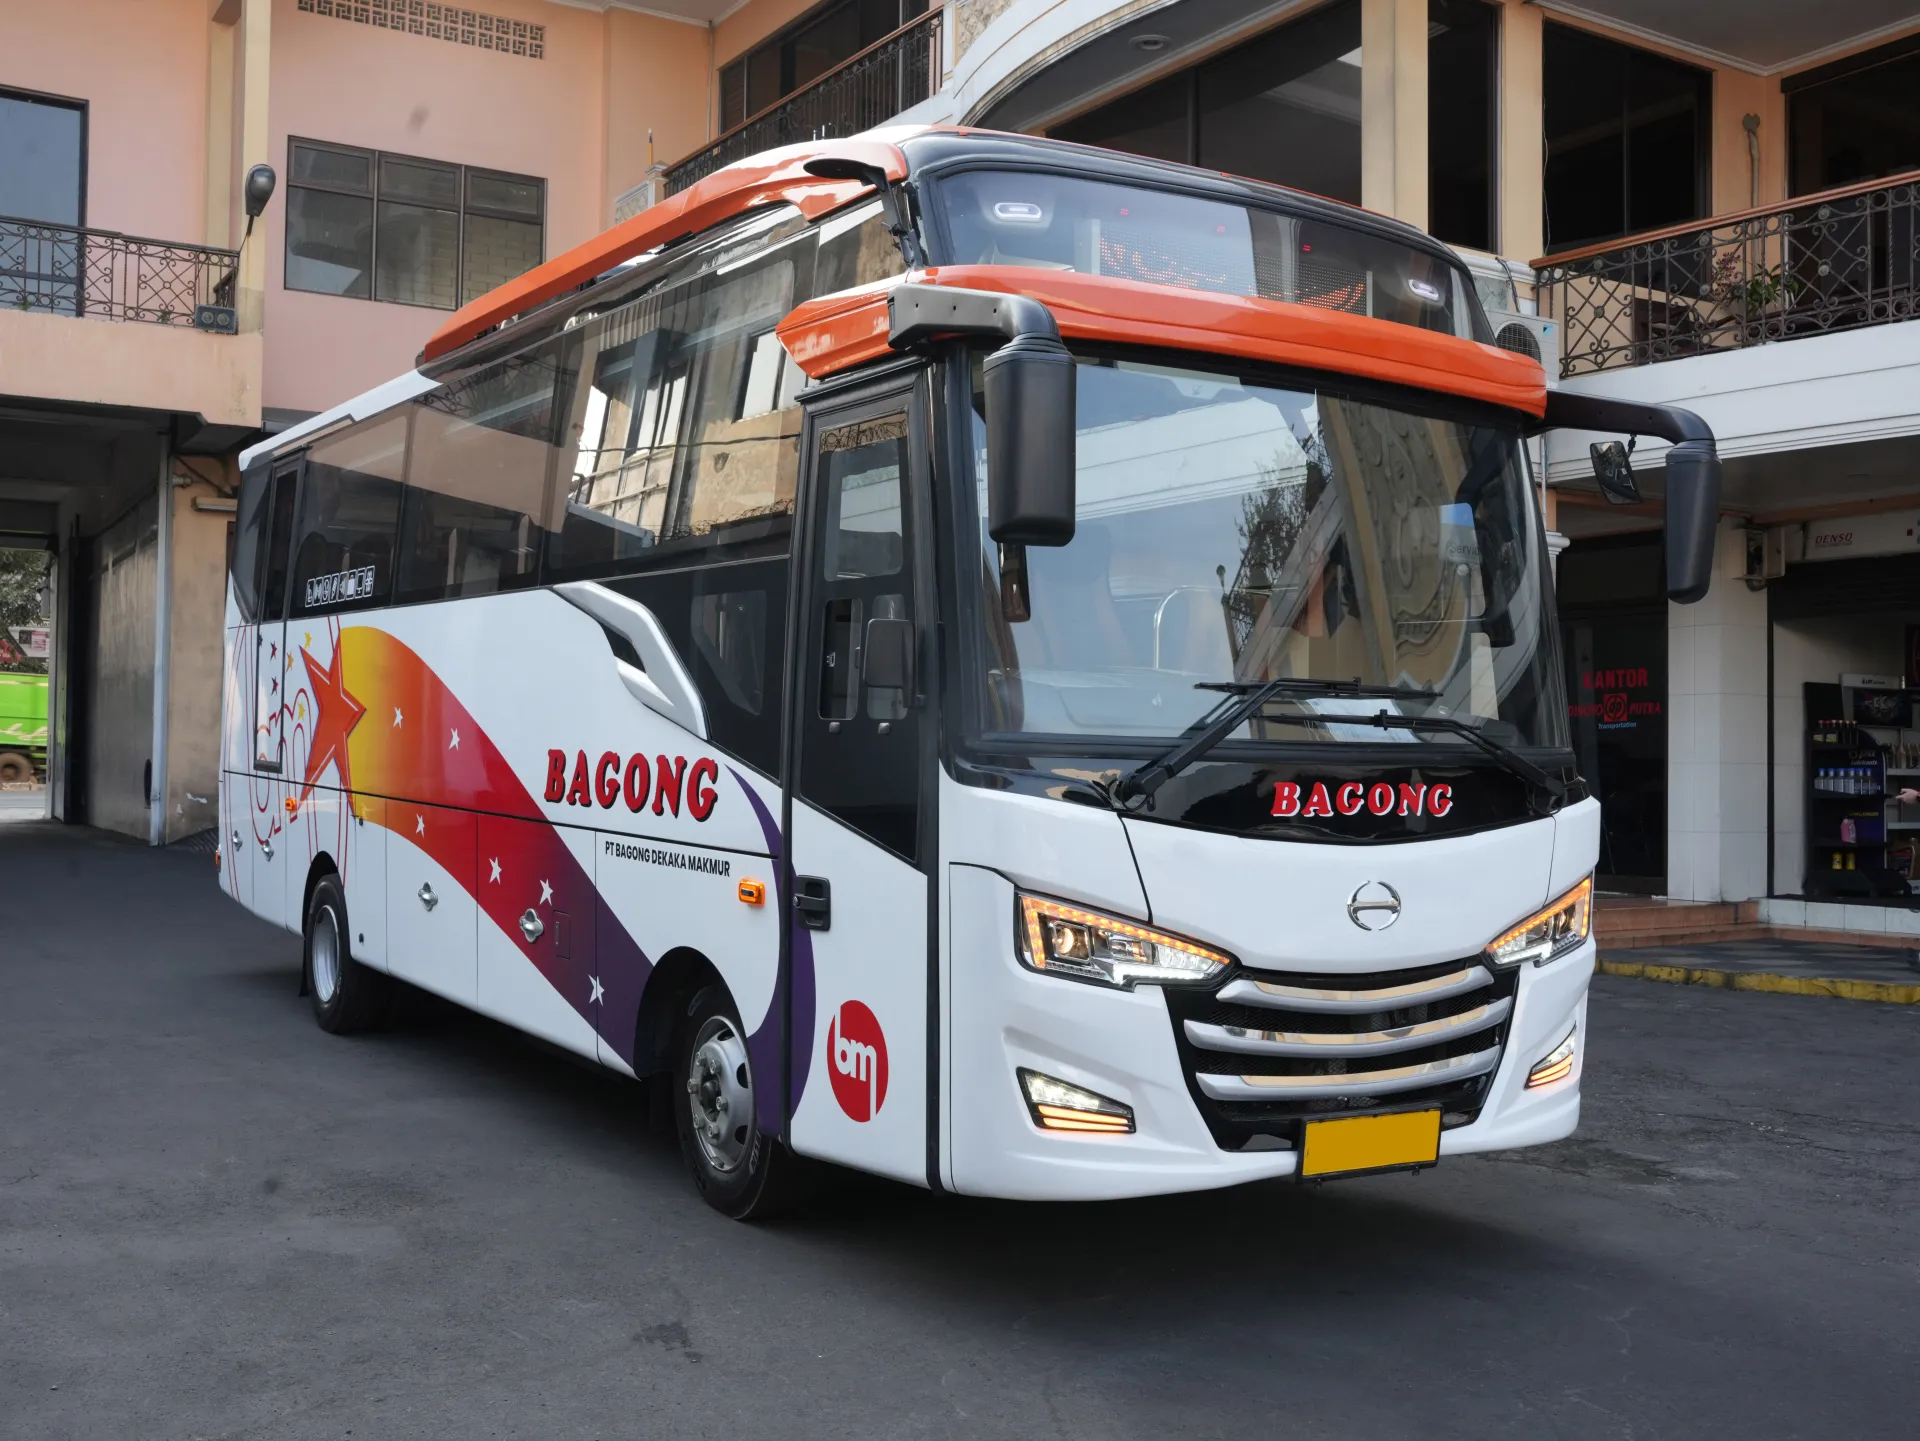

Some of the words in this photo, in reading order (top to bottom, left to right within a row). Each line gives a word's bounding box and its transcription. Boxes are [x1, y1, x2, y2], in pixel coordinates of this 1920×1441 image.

[1815, 533, 1853, 544] DENSO
[1583, 668, 1648, 689] KANTOR
[1629, 701, 1661, 715] PUTRA
[1598, 721, 1637, 730] Transportation
[544, 748, 718, 823] BAGONG
[1270, 781, 1453, 818] BAGONG
[605, 840, 614, 856] PT
[615, 843, 651, 862] BAGONG
[651, 849, 687, 870] DEKAKA
[688, 854, 730, 877] MAKMUR
